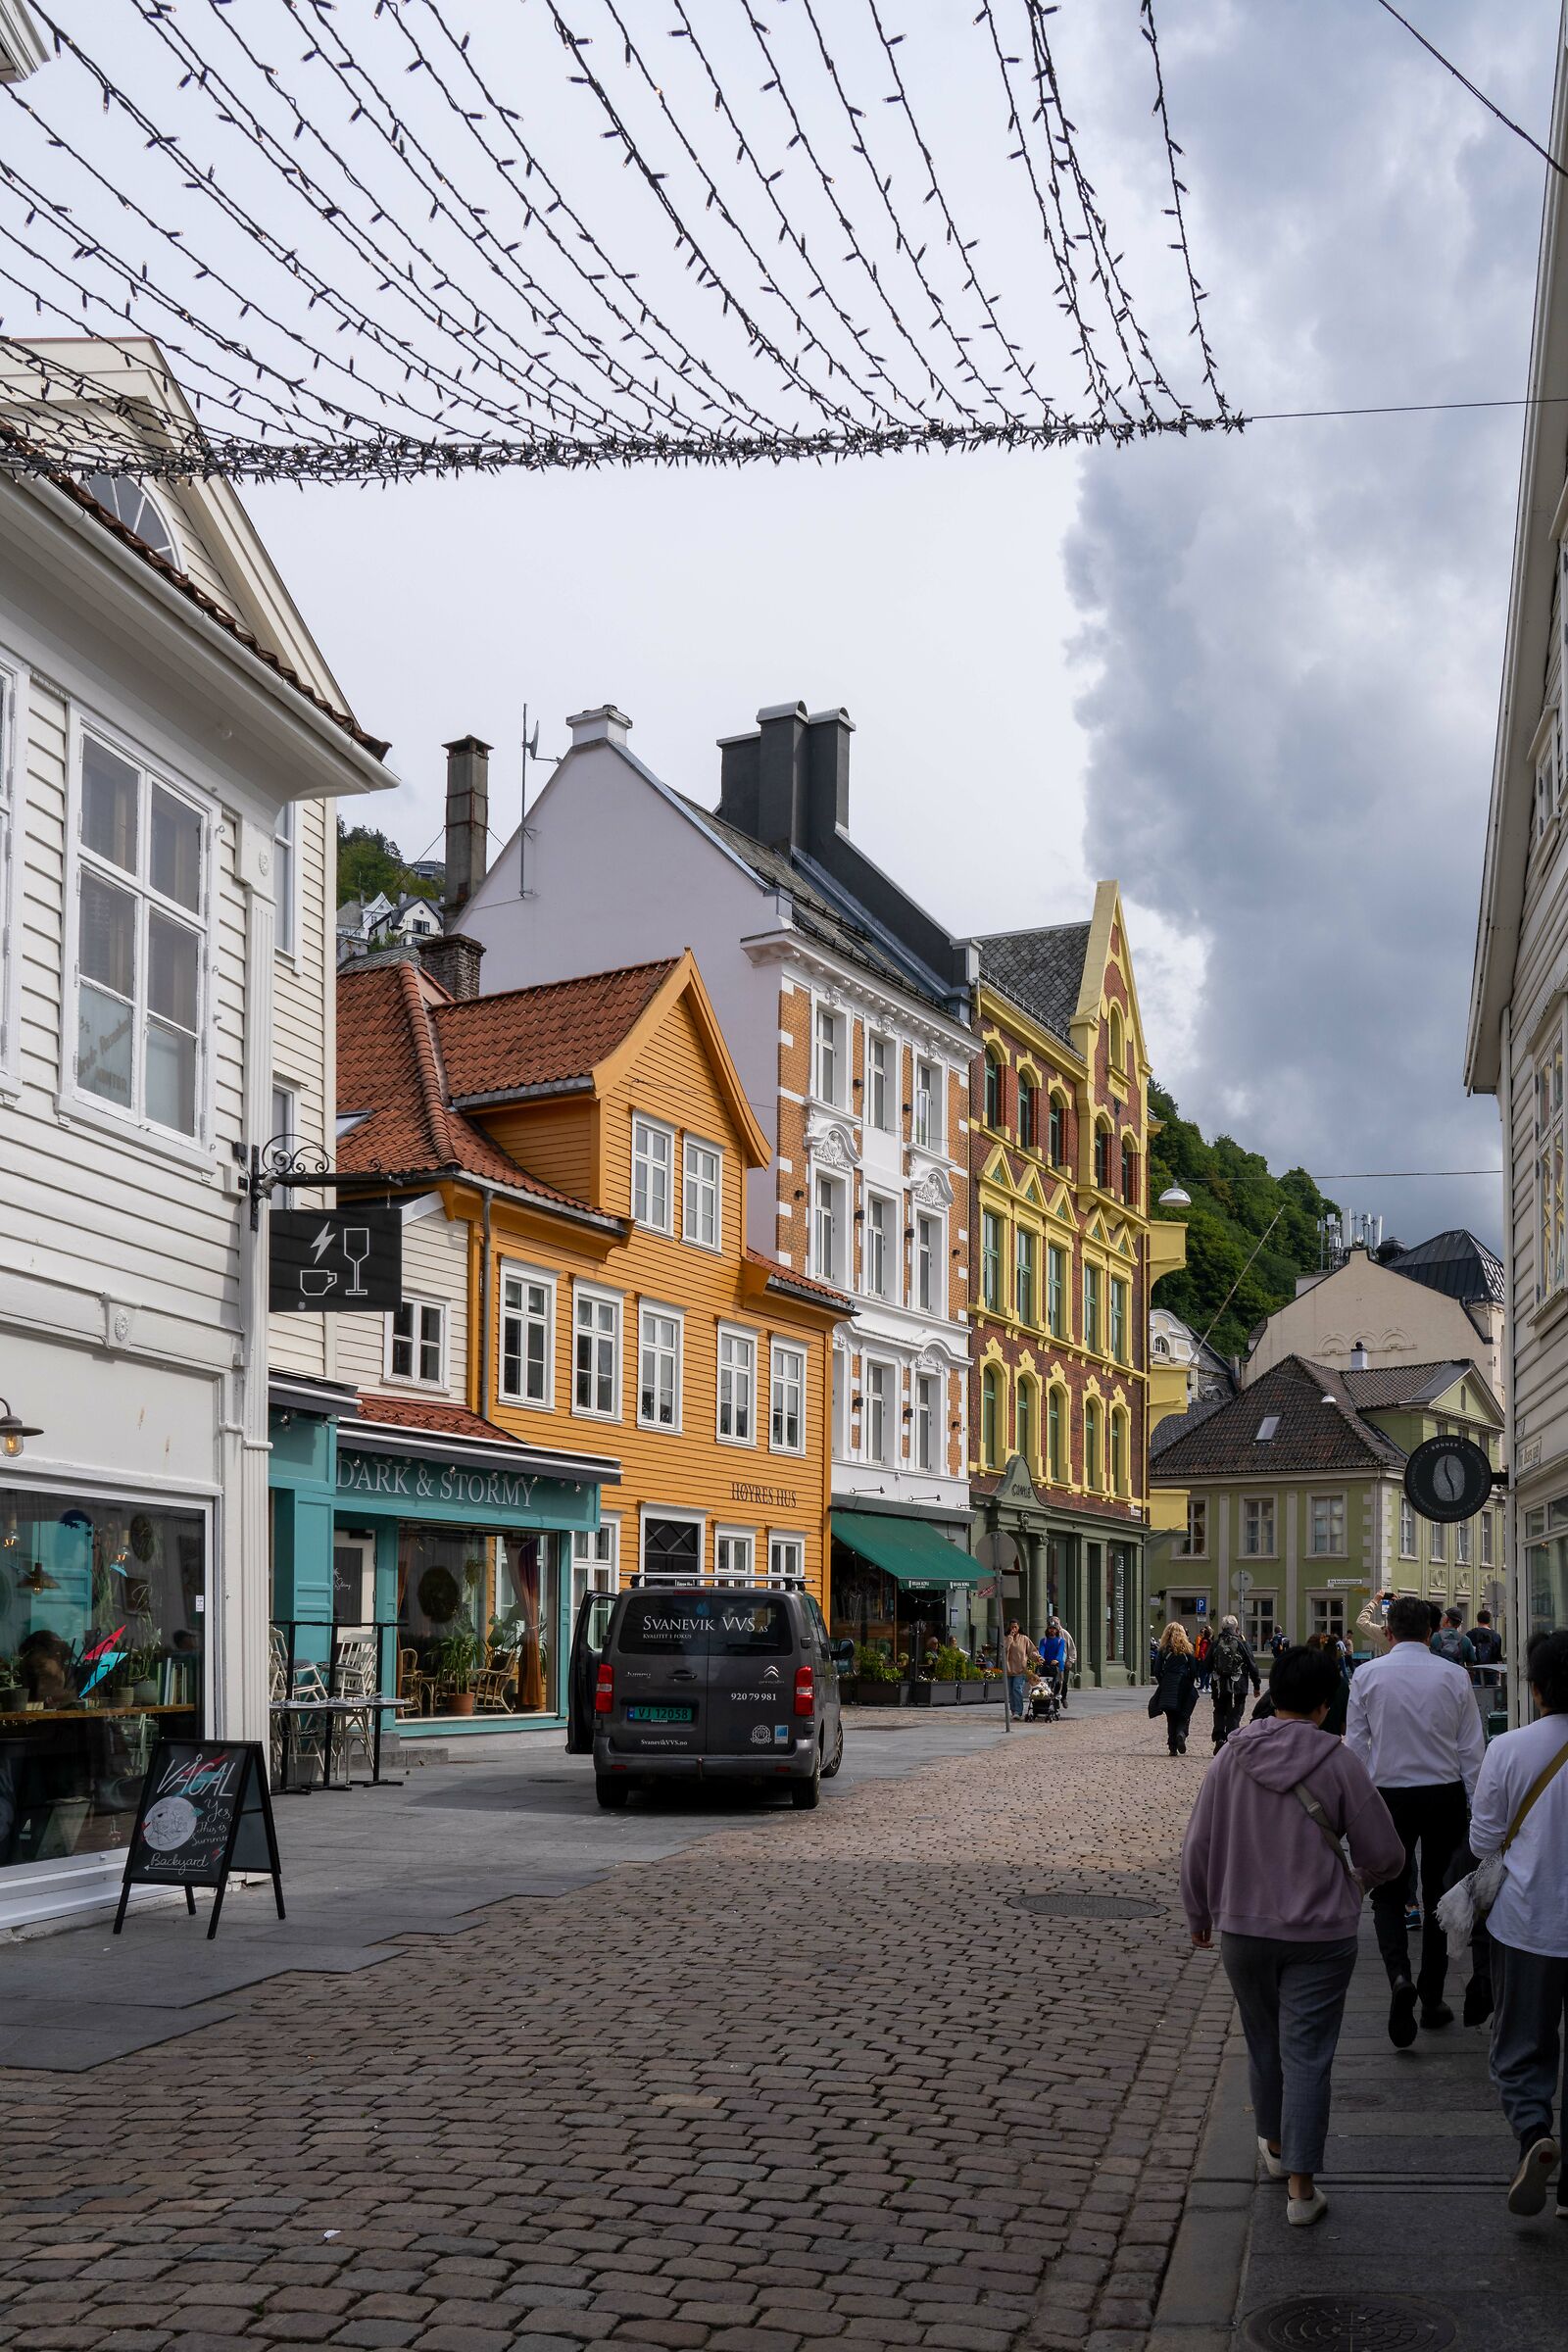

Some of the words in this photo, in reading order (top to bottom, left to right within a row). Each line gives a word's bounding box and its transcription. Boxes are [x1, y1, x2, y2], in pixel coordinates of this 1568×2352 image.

[336, 1458, 411, 1494] DARK
[416, 1467, 435, 1497] &
[440, 1471, 534, 1507] STORMY
[730, 1482, 774, 1504] HØYRES
[776, 1489, 798, 1508] HUS
[1199, 1599, 1204, 1611] P
[721, 1616, 756, 1633] VVS
[731, 1692, 748, 1701] 920
[749, 1692, 760, 1701] 79
[760, 1692, 777, 1701] 981
[638, 1708, 652, 1719] VJ
[656, 1708, 688, 1720] 12058
[157, 1753, 235, 1796] VÅGAL
[150, 1852, 209, 1876] Backyard
